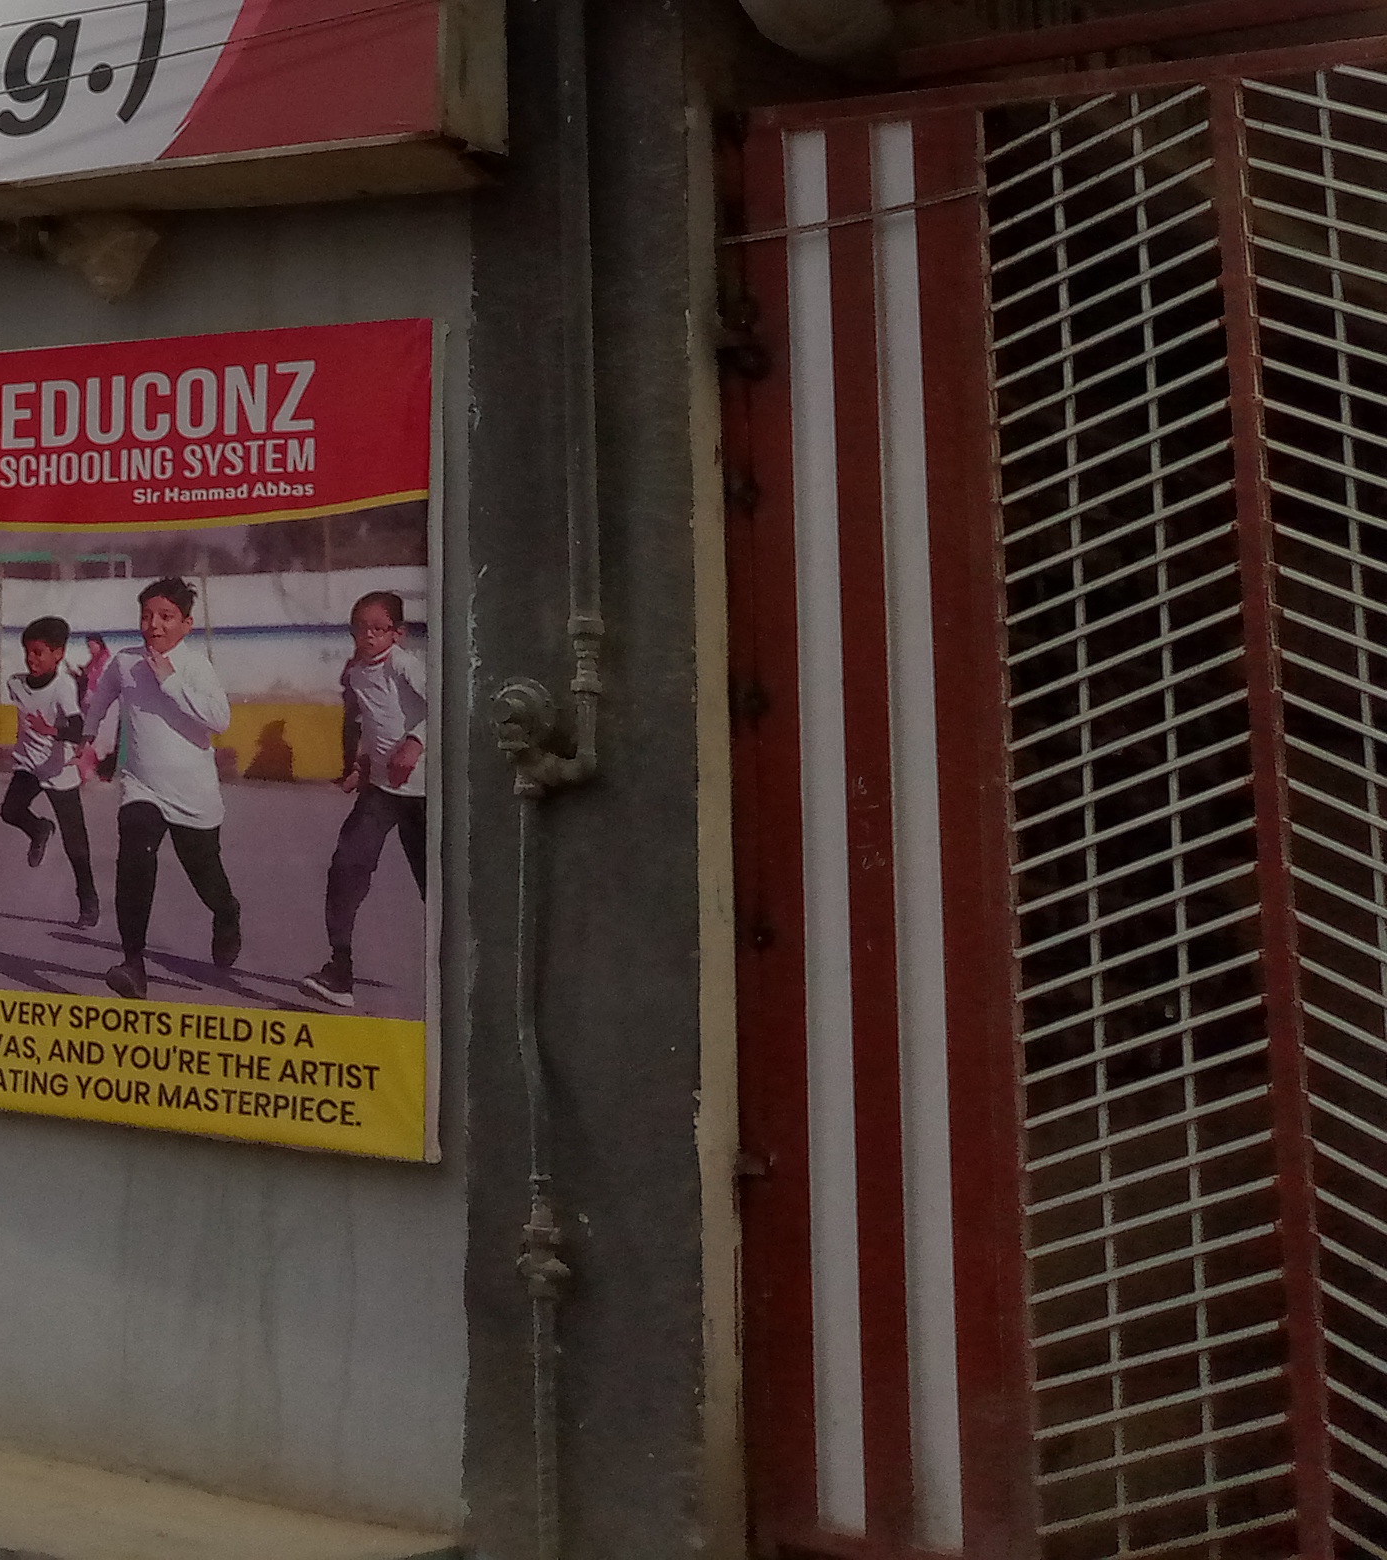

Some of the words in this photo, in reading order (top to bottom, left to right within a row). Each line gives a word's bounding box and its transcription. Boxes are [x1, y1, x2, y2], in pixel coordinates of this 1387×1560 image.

[0, 359, 316, 451] EDUCONZ
[182, 437, 316, 480] SYSTEM
[132, 487, 161, 505] Sir
[164, 482, 249, 503] Hammad
[252, 480, 315, 499] Abbas
[69, 1005, 173, 1037] SPORTS
[179, 1013, 253, 1042] FIELD
[260, 1019, 287, 1047] IS
[293, 1023, 315, 1049] A
[47, 1039, 105, 1065] AND
[111, 1044, 211, 1076] YOU'RE
[216, 1052, 272, 1082] THE
[277, 1058, 381, 1092] ARTIST
[75, 1075, 151, 1106] YOUR
[156, 1083, 363, 1127] MASTERPIECE.
